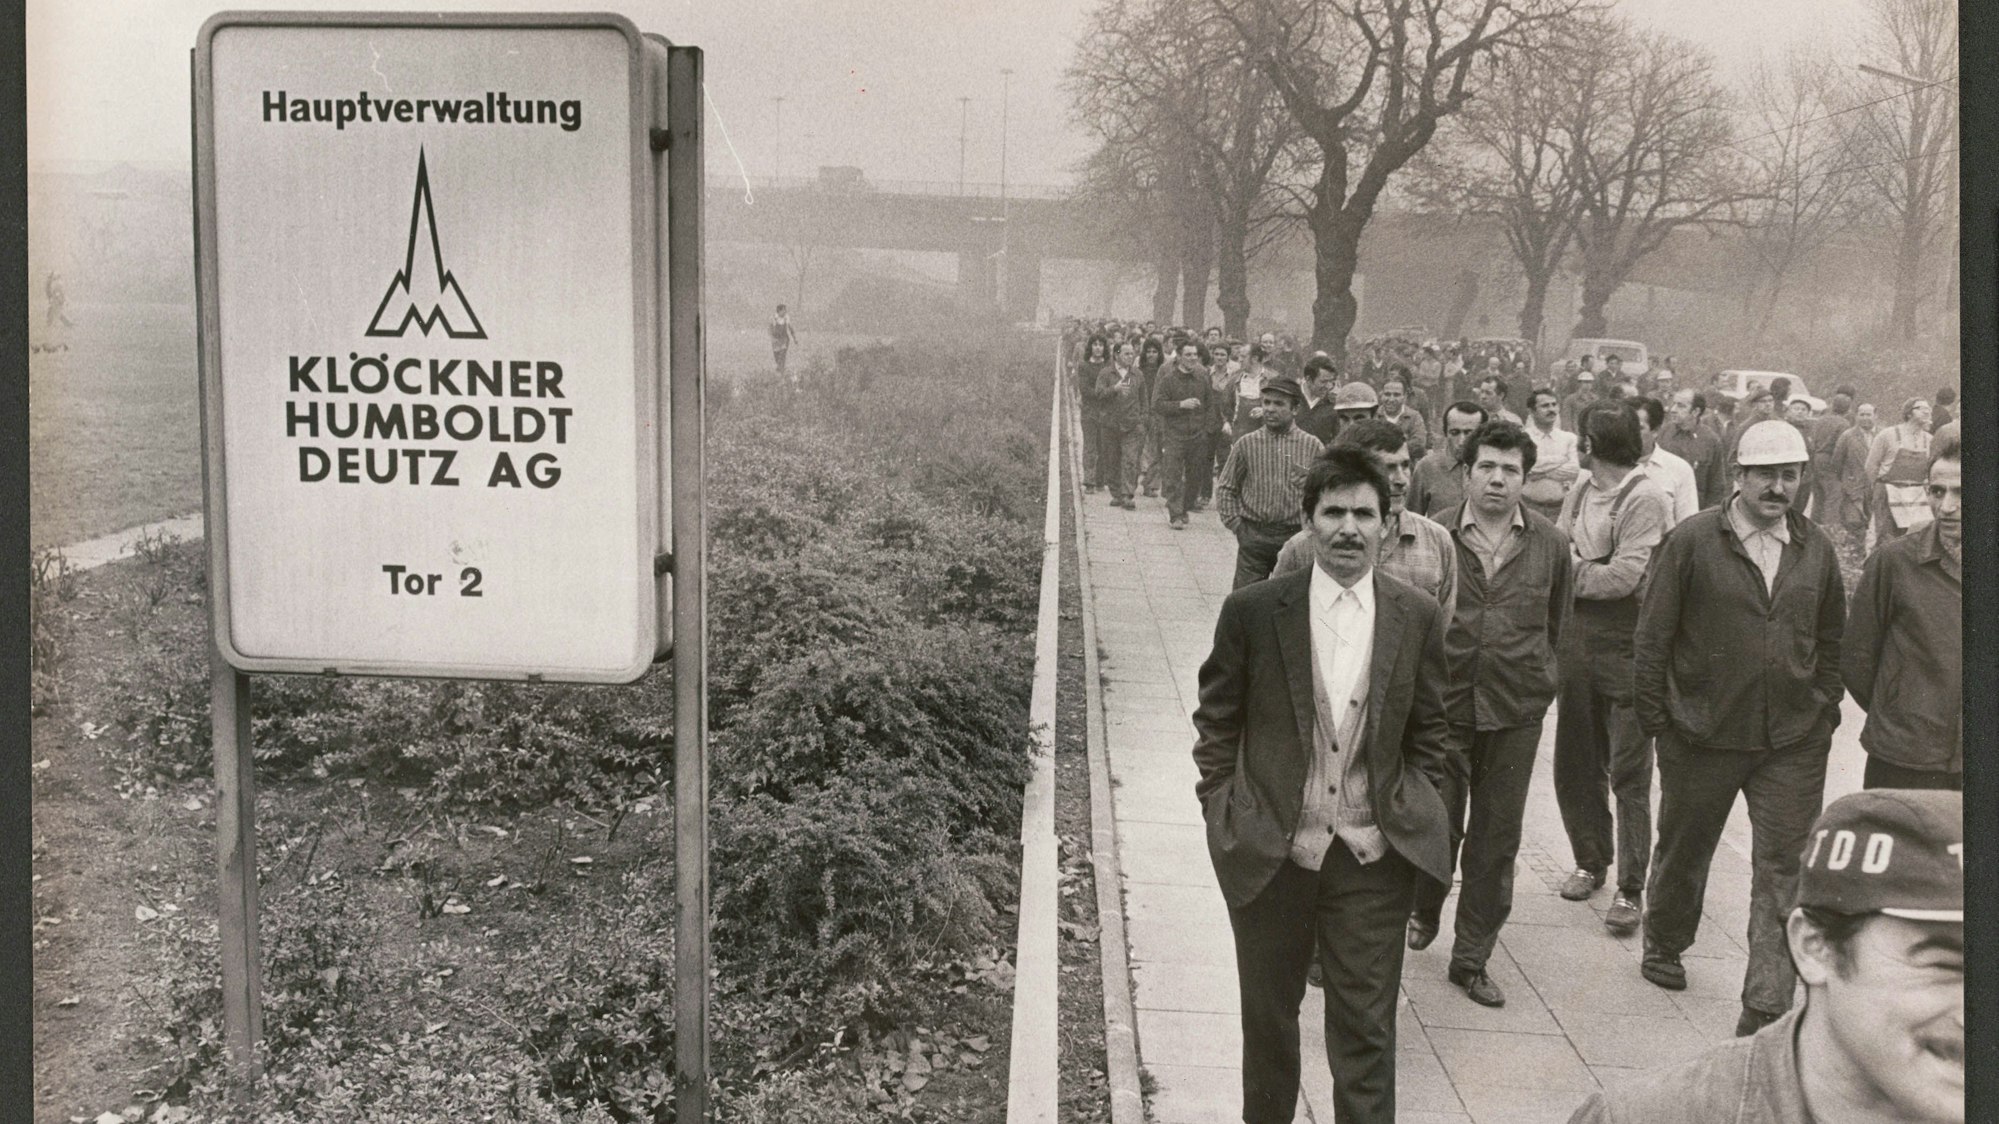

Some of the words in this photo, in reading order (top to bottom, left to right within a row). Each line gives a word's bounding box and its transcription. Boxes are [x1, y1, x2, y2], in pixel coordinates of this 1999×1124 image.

[262, 90, 582, 132] Hauptverwaltung
[289, 352, 566, 399] KLÖCKNER
[286, 401, 574, 445] HUMBOLDT
[299, 446, 461, 487] DEUTZ
[487, 451, 563, 490] AG
[382, 564, 443, 596] Tor
[460, 567, 484, 598] 2
